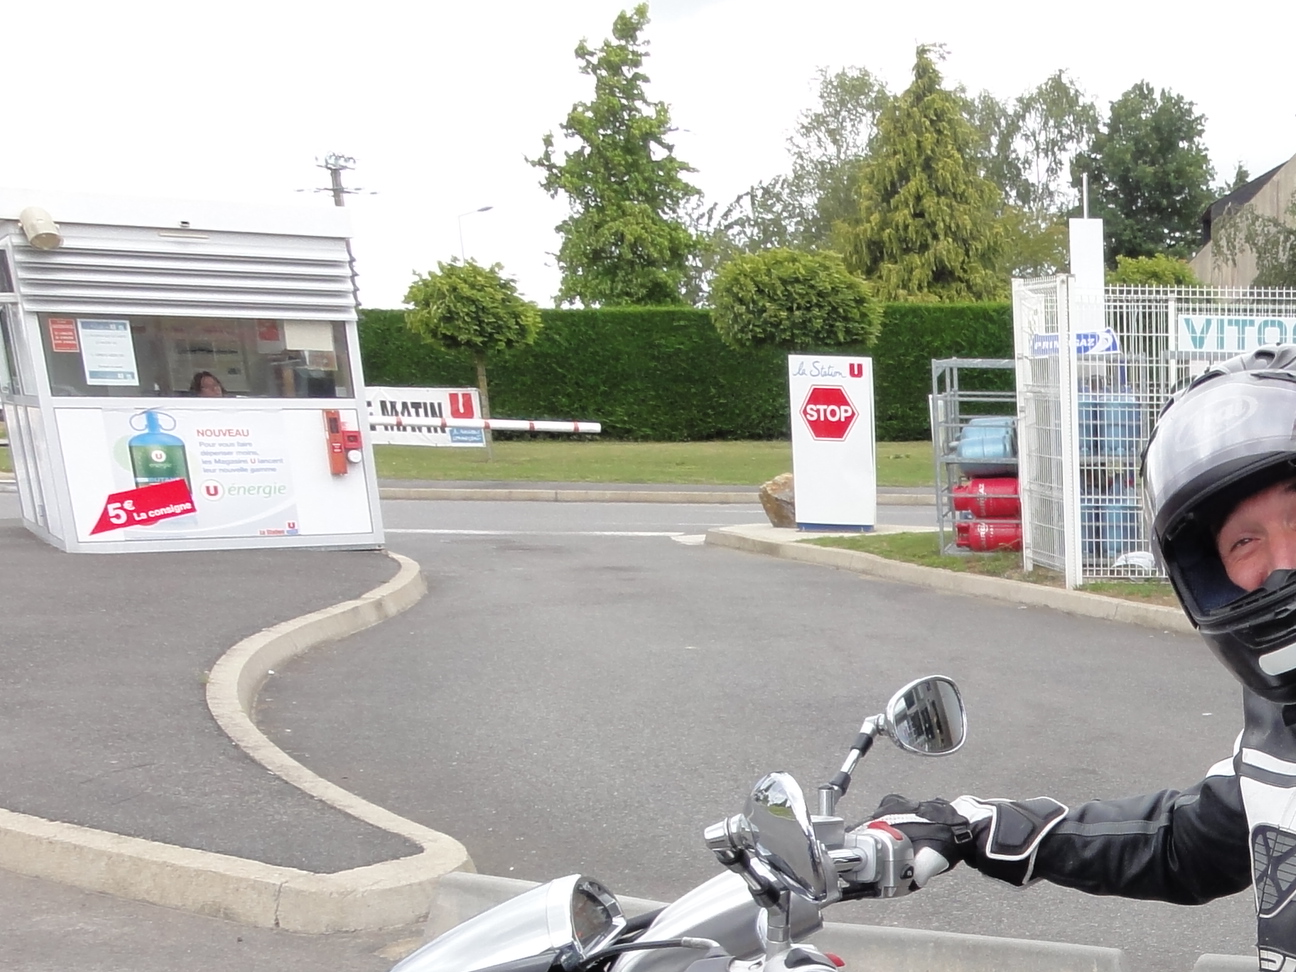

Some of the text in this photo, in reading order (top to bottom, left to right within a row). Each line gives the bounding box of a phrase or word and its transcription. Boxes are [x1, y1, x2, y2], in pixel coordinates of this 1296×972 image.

[809, 360, 847, 378] Station
[849, 363, 863, 378] U
[448, 393, 474, 419] U
[806, 404, 853, 422] STOP
[380, 400, 446, 433] MATIN
[196, 429, 250, 438] NOUVEAU
[205, 482, 287, 499] U énergie
[148, 502, 192, 518] consigne
